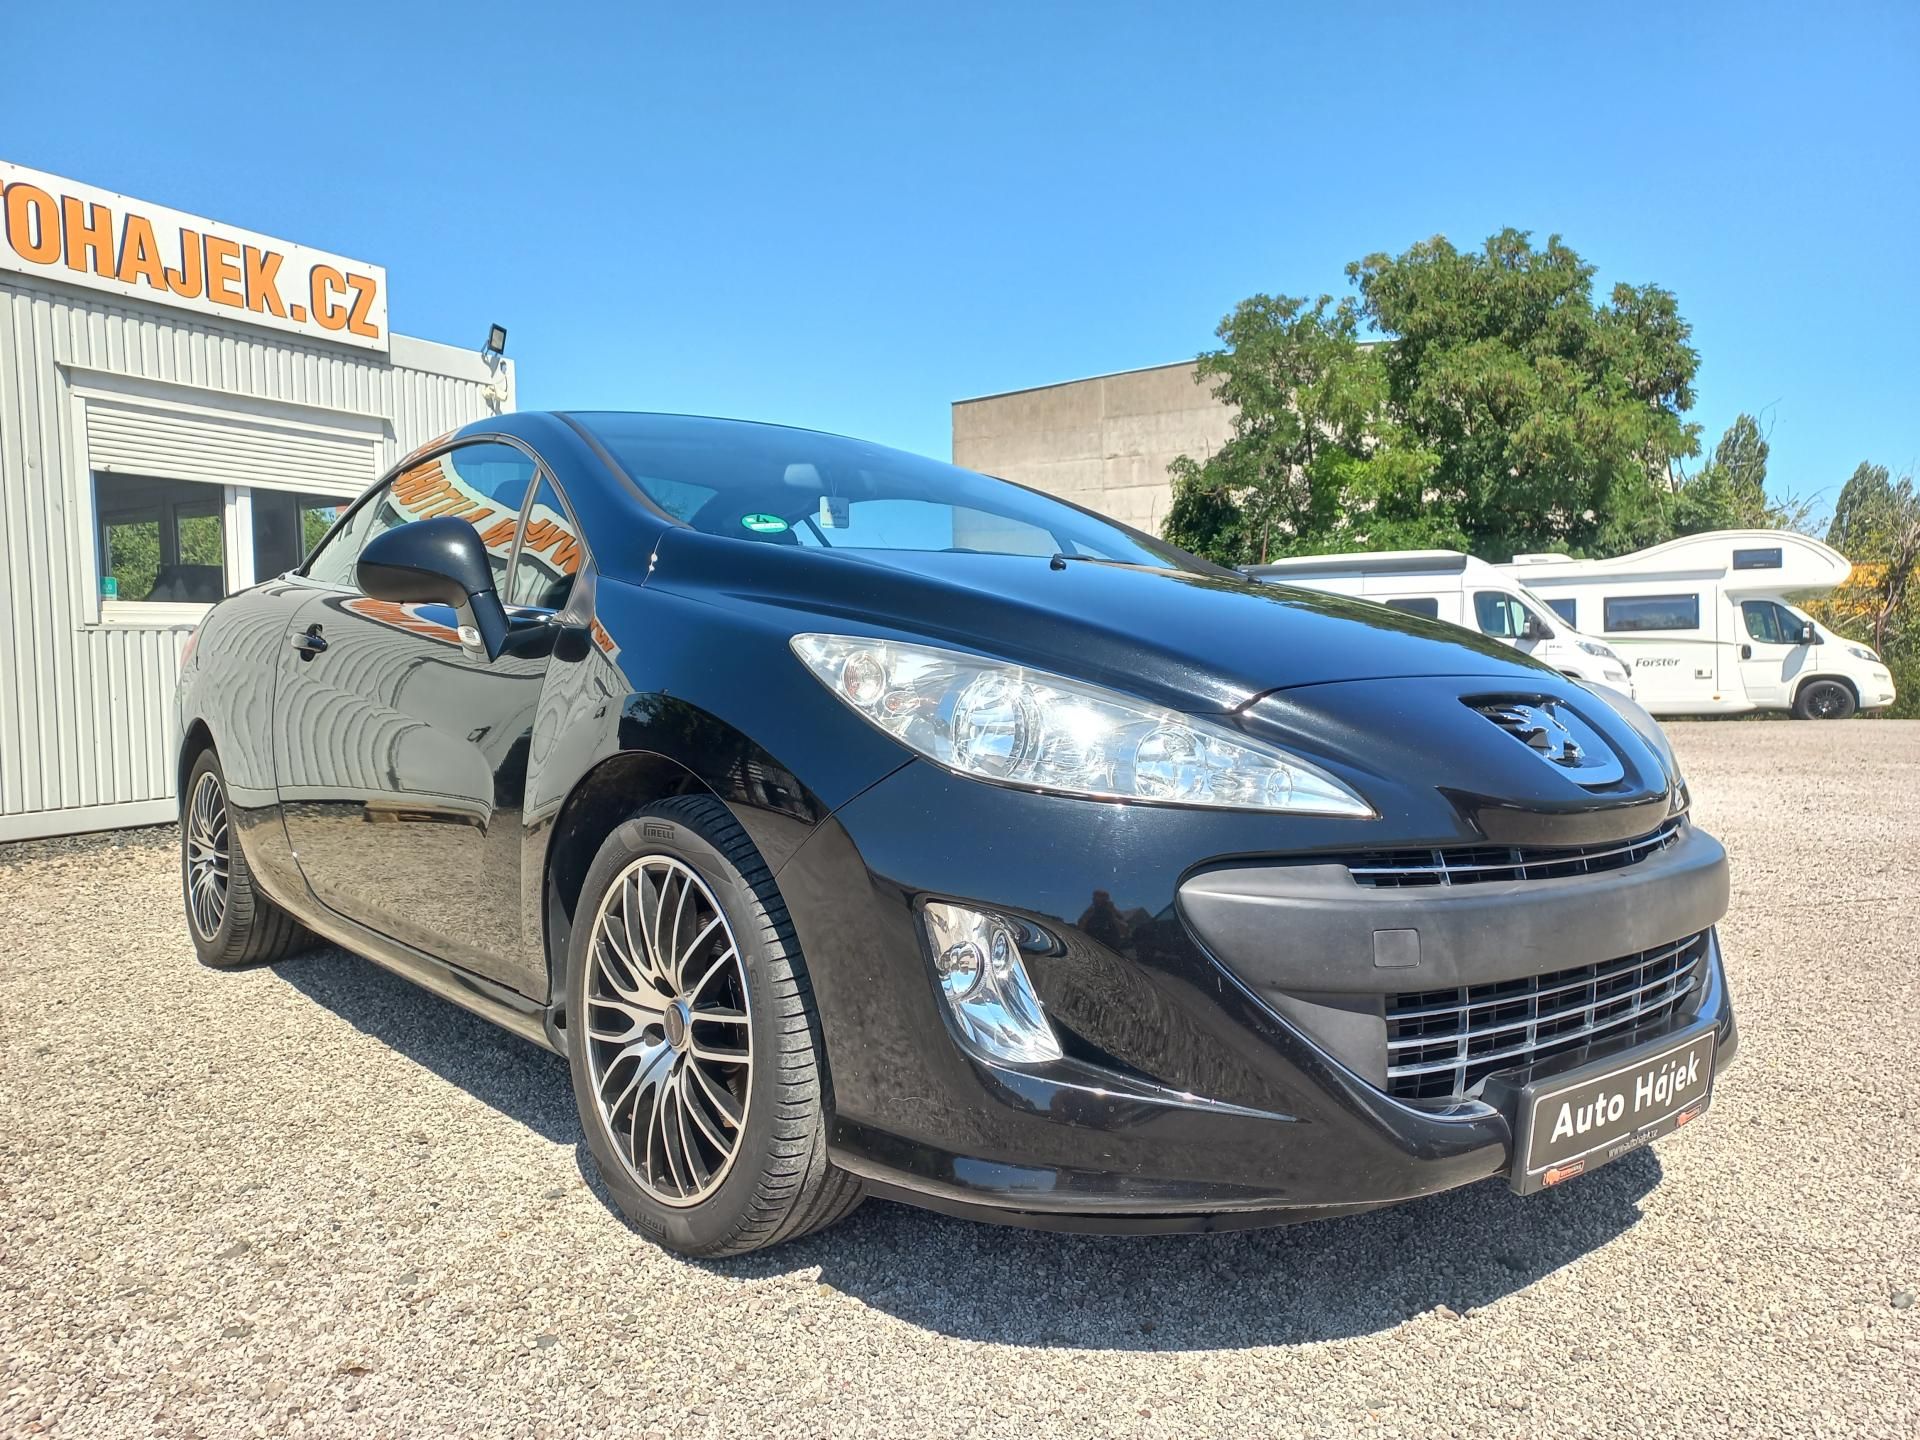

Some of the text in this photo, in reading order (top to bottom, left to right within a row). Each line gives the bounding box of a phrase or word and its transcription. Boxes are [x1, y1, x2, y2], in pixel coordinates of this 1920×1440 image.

[0, 179, 379, 339] OHAJEK.CZ
[1635, 657, 1681, 668] Forster
[643, 822, 676, 840] PIRELLI
[1550, 1051, 1701, 1144] Auto Hájek
